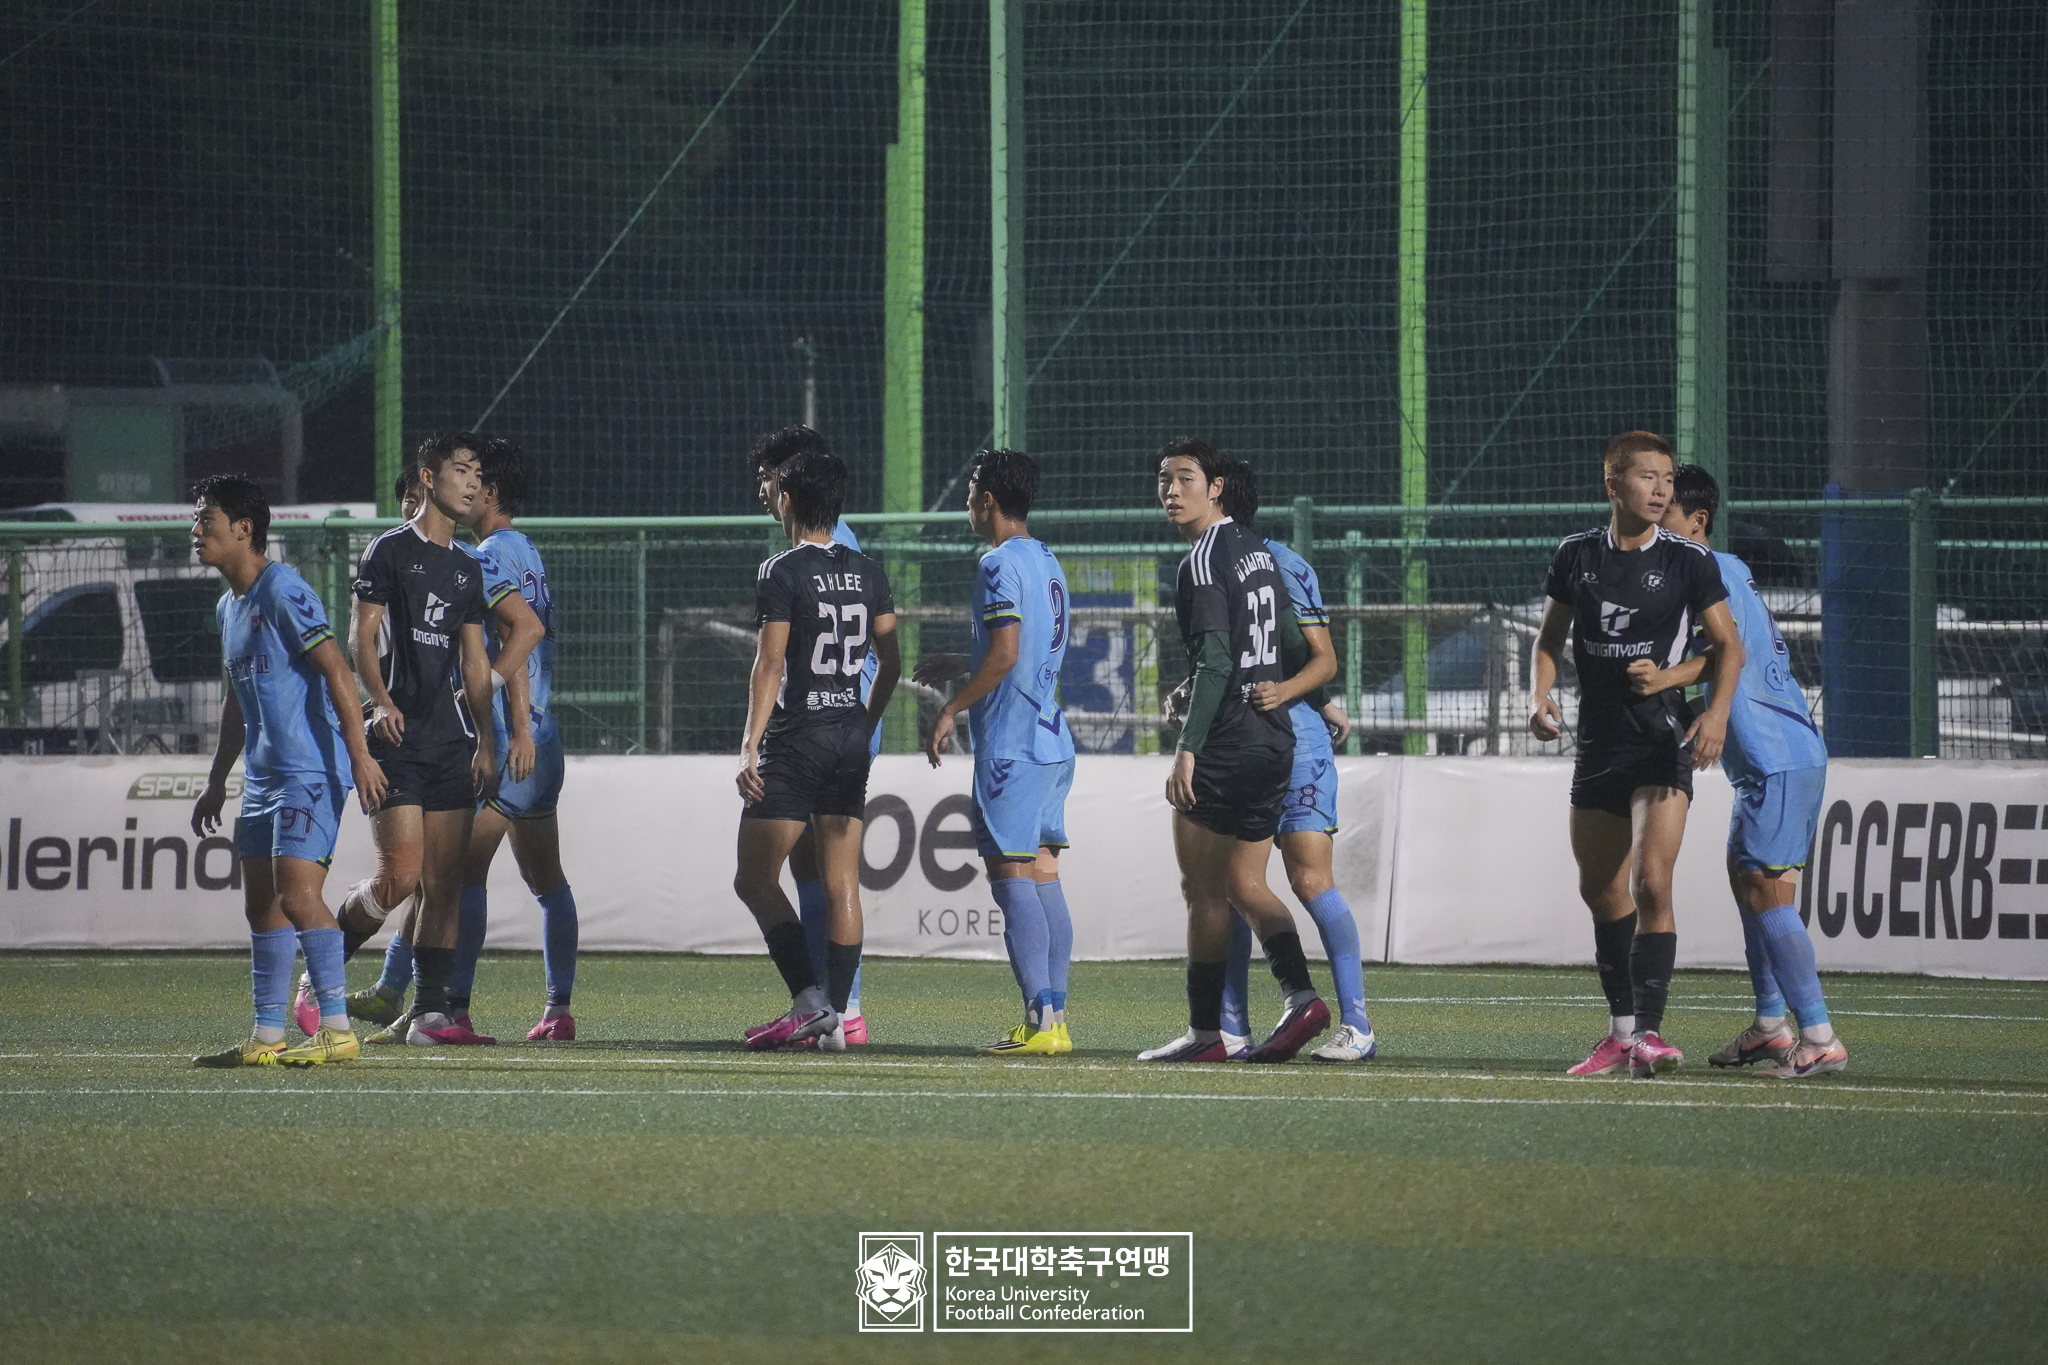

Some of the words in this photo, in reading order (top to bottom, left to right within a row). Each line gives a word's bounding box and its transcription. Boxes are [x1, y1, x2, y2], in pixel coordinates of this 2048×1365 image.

[811, 601, 868, 677] 22
[1048, 578, 1066, 654] 9
[1240, 585, 1277, 669] 32
[136, 775, 242, 798] SPORS
[278, 806, 313, 836] 91
[0, 817, 243, 891] lerind
[917, 909, 1001, 937] KORE
